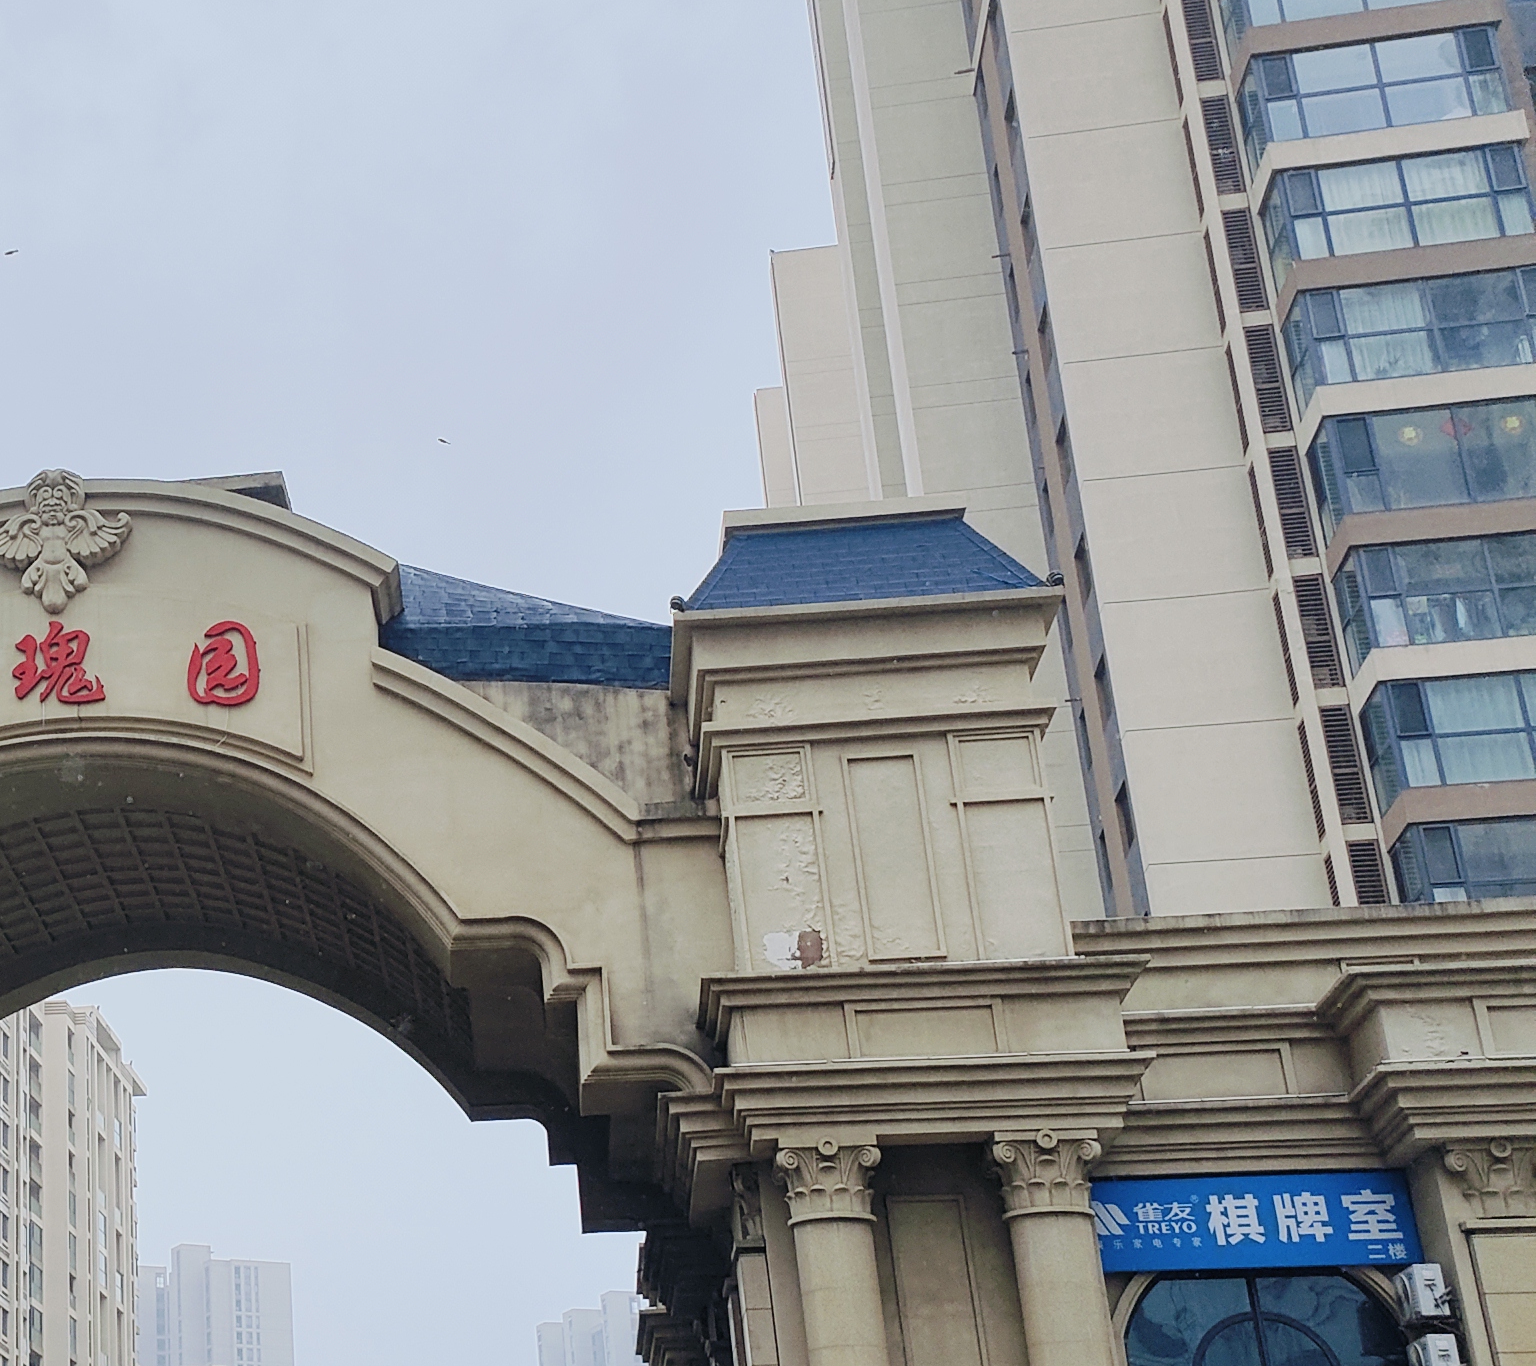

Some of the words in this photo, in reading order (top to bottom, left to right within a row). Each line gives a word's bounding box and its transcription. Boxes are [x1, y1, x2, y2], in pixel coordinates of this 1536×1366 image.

[1133, 1202, 1195, 1222] 雀友
[1205, 1189, 1404, 1246] 棋牌室
[1135, 1220, 1197, 1235] TREYO
[1367, 1242, 1408, 1260] 二楼
